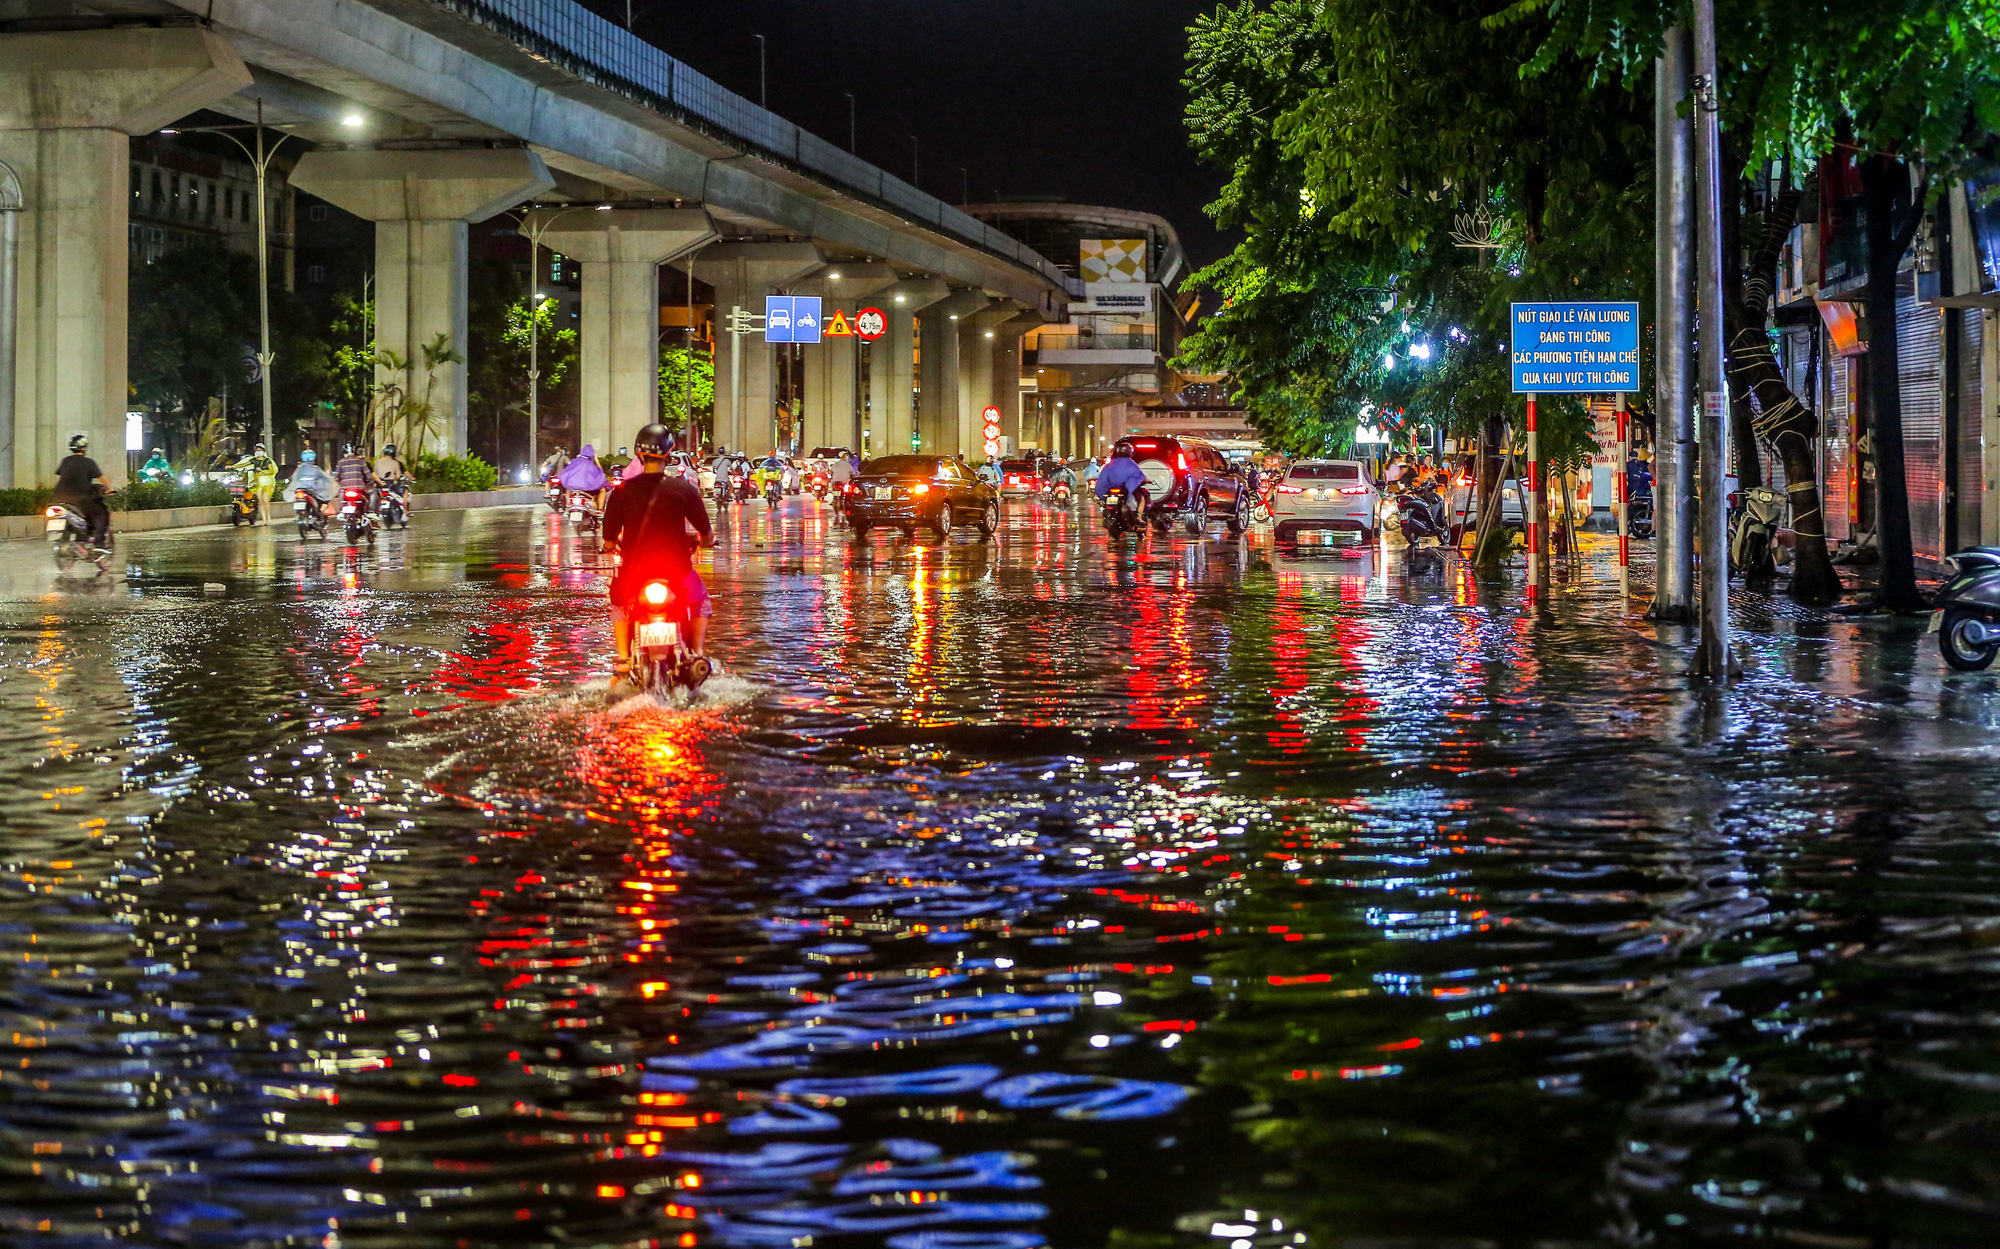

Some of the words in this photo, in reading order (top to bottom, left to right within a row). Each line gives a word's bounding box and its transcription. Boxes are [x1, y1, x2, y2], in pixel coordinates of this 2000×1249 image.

[1518, 308, 1537, 323] NÚT
[1539, 311, 1561, 323] GIAO
[1563, 308, 1575, 323] LÊ
[1577, 308, 1596, 323] VĂN
[1598, 310, 1630, 323] LƯƠNG
[1539, 331, 1565, 343] ĐANG
[1568, 331, 1583, 343] THI
[1585, 329, 1611, 343] CÔNG
[1513, 349, 1532, 364] CÁC
[1534, 351, 1572, 364] PHƯƠNG
[1574, 349, 1595, 365] TIỆN
[1597, 351, 1616, 365] HẠN
[1619, 347, 1638, 363] CHẾ
[1522, 372, 1541, 384] QUA
[1543, 372, 1562, 384] KHU
[1565, 372, 1584, 386] VỰC
[1586, 372, 1602, 384] THI
[1604, 370, 1630, 384] CÔNG
